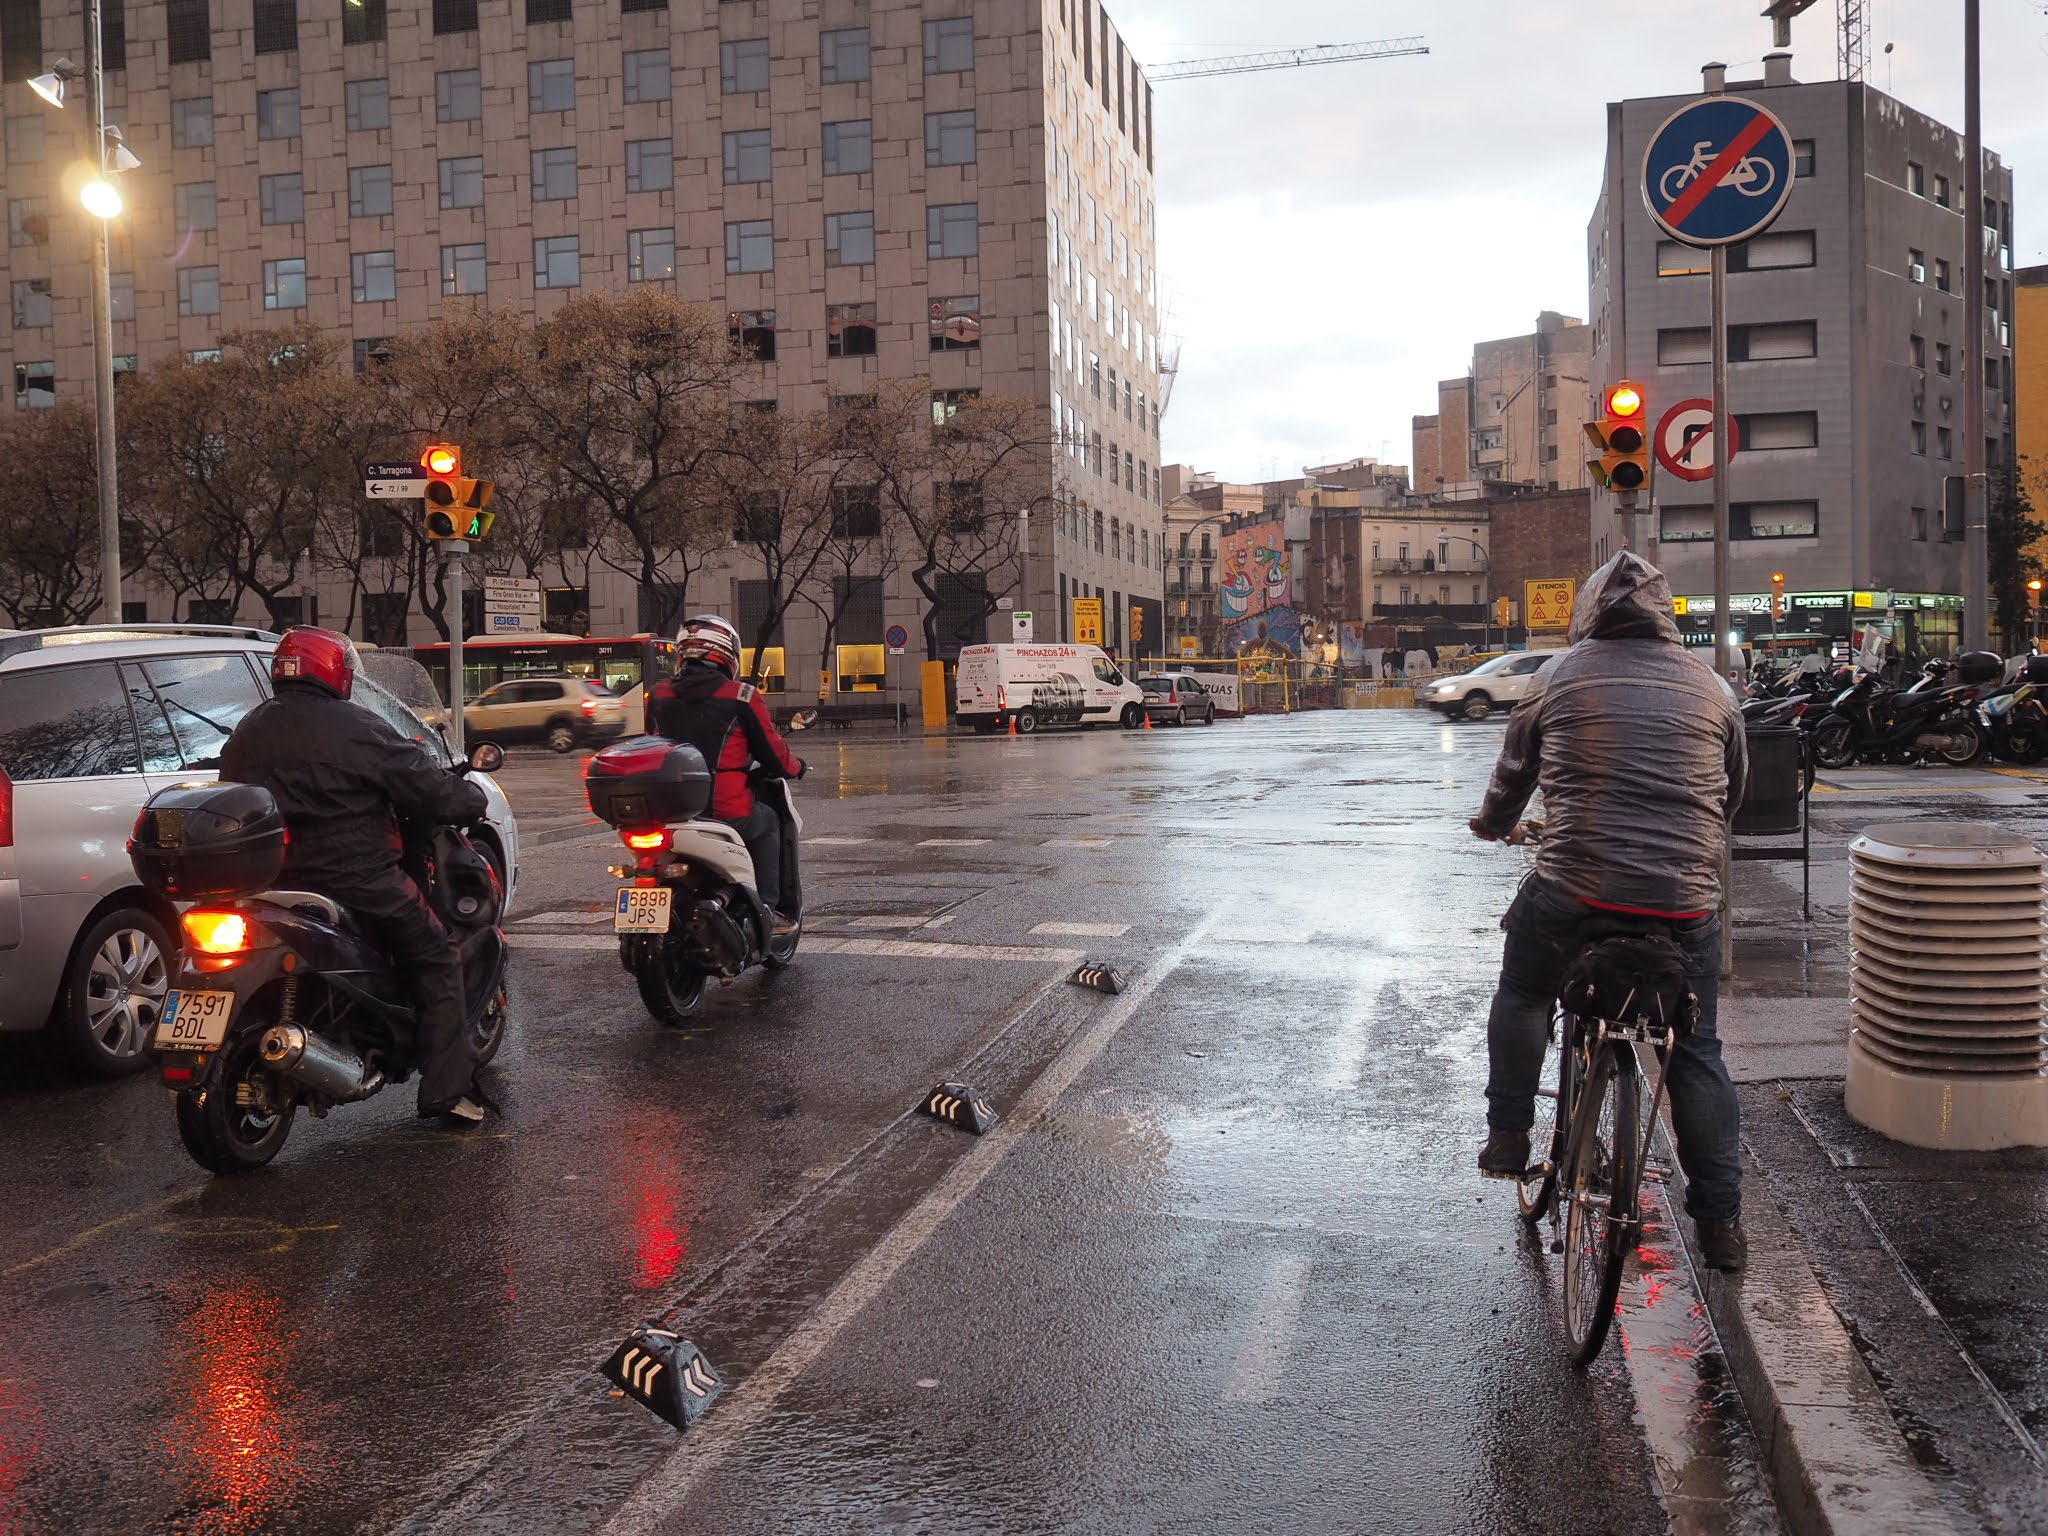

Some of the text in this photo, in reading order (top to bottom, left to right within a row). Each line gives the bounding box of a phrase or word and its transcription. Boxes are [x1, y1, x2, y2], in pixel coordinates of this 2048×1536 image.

[368, 466, 412, 476] C. Tarragona
[1767, 639, 1810, 648] Cntinental
[983, 646, 991, 655] 24
[1016, 649, 1058, 657] PINCHAZOS
[1059, 647, 1070, 657] 24
[630, 891, 667, 907] 6898
[628, 908, 656, 924] JPS
[178, 994, 226, 1017] 7591
[166, 1010, 172, 1018] E
[172, 1017, 207, 1040] BDL
